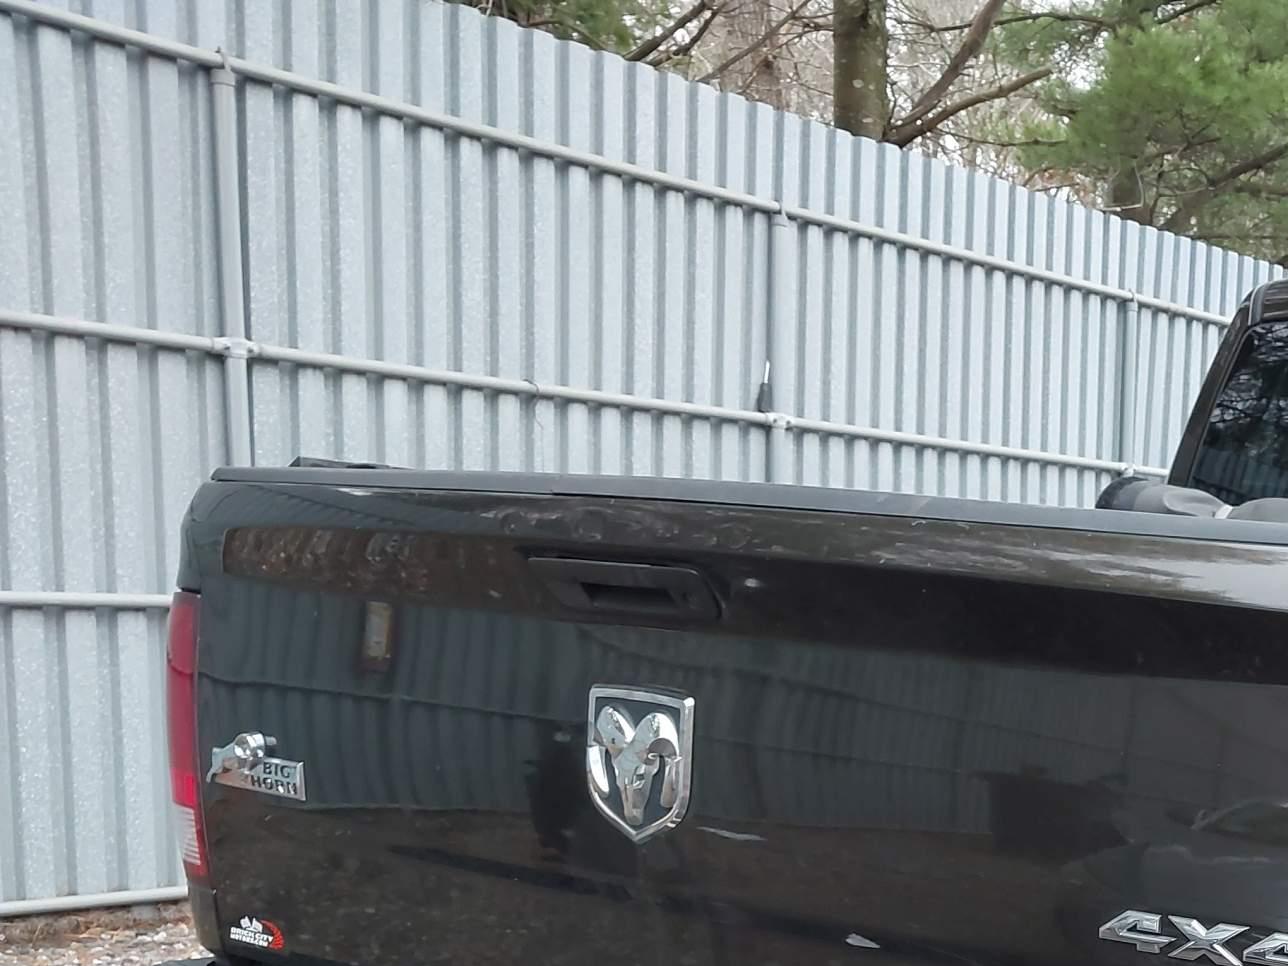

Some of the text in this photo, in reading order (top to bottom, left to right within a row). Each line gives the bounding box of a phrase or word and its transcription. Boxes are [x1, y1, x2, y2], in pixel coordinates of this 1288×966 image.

[263, 762, 291, 778] BIG
[251, 775, 298, 795] HORN
[255, 932, 274, 943] CITY
